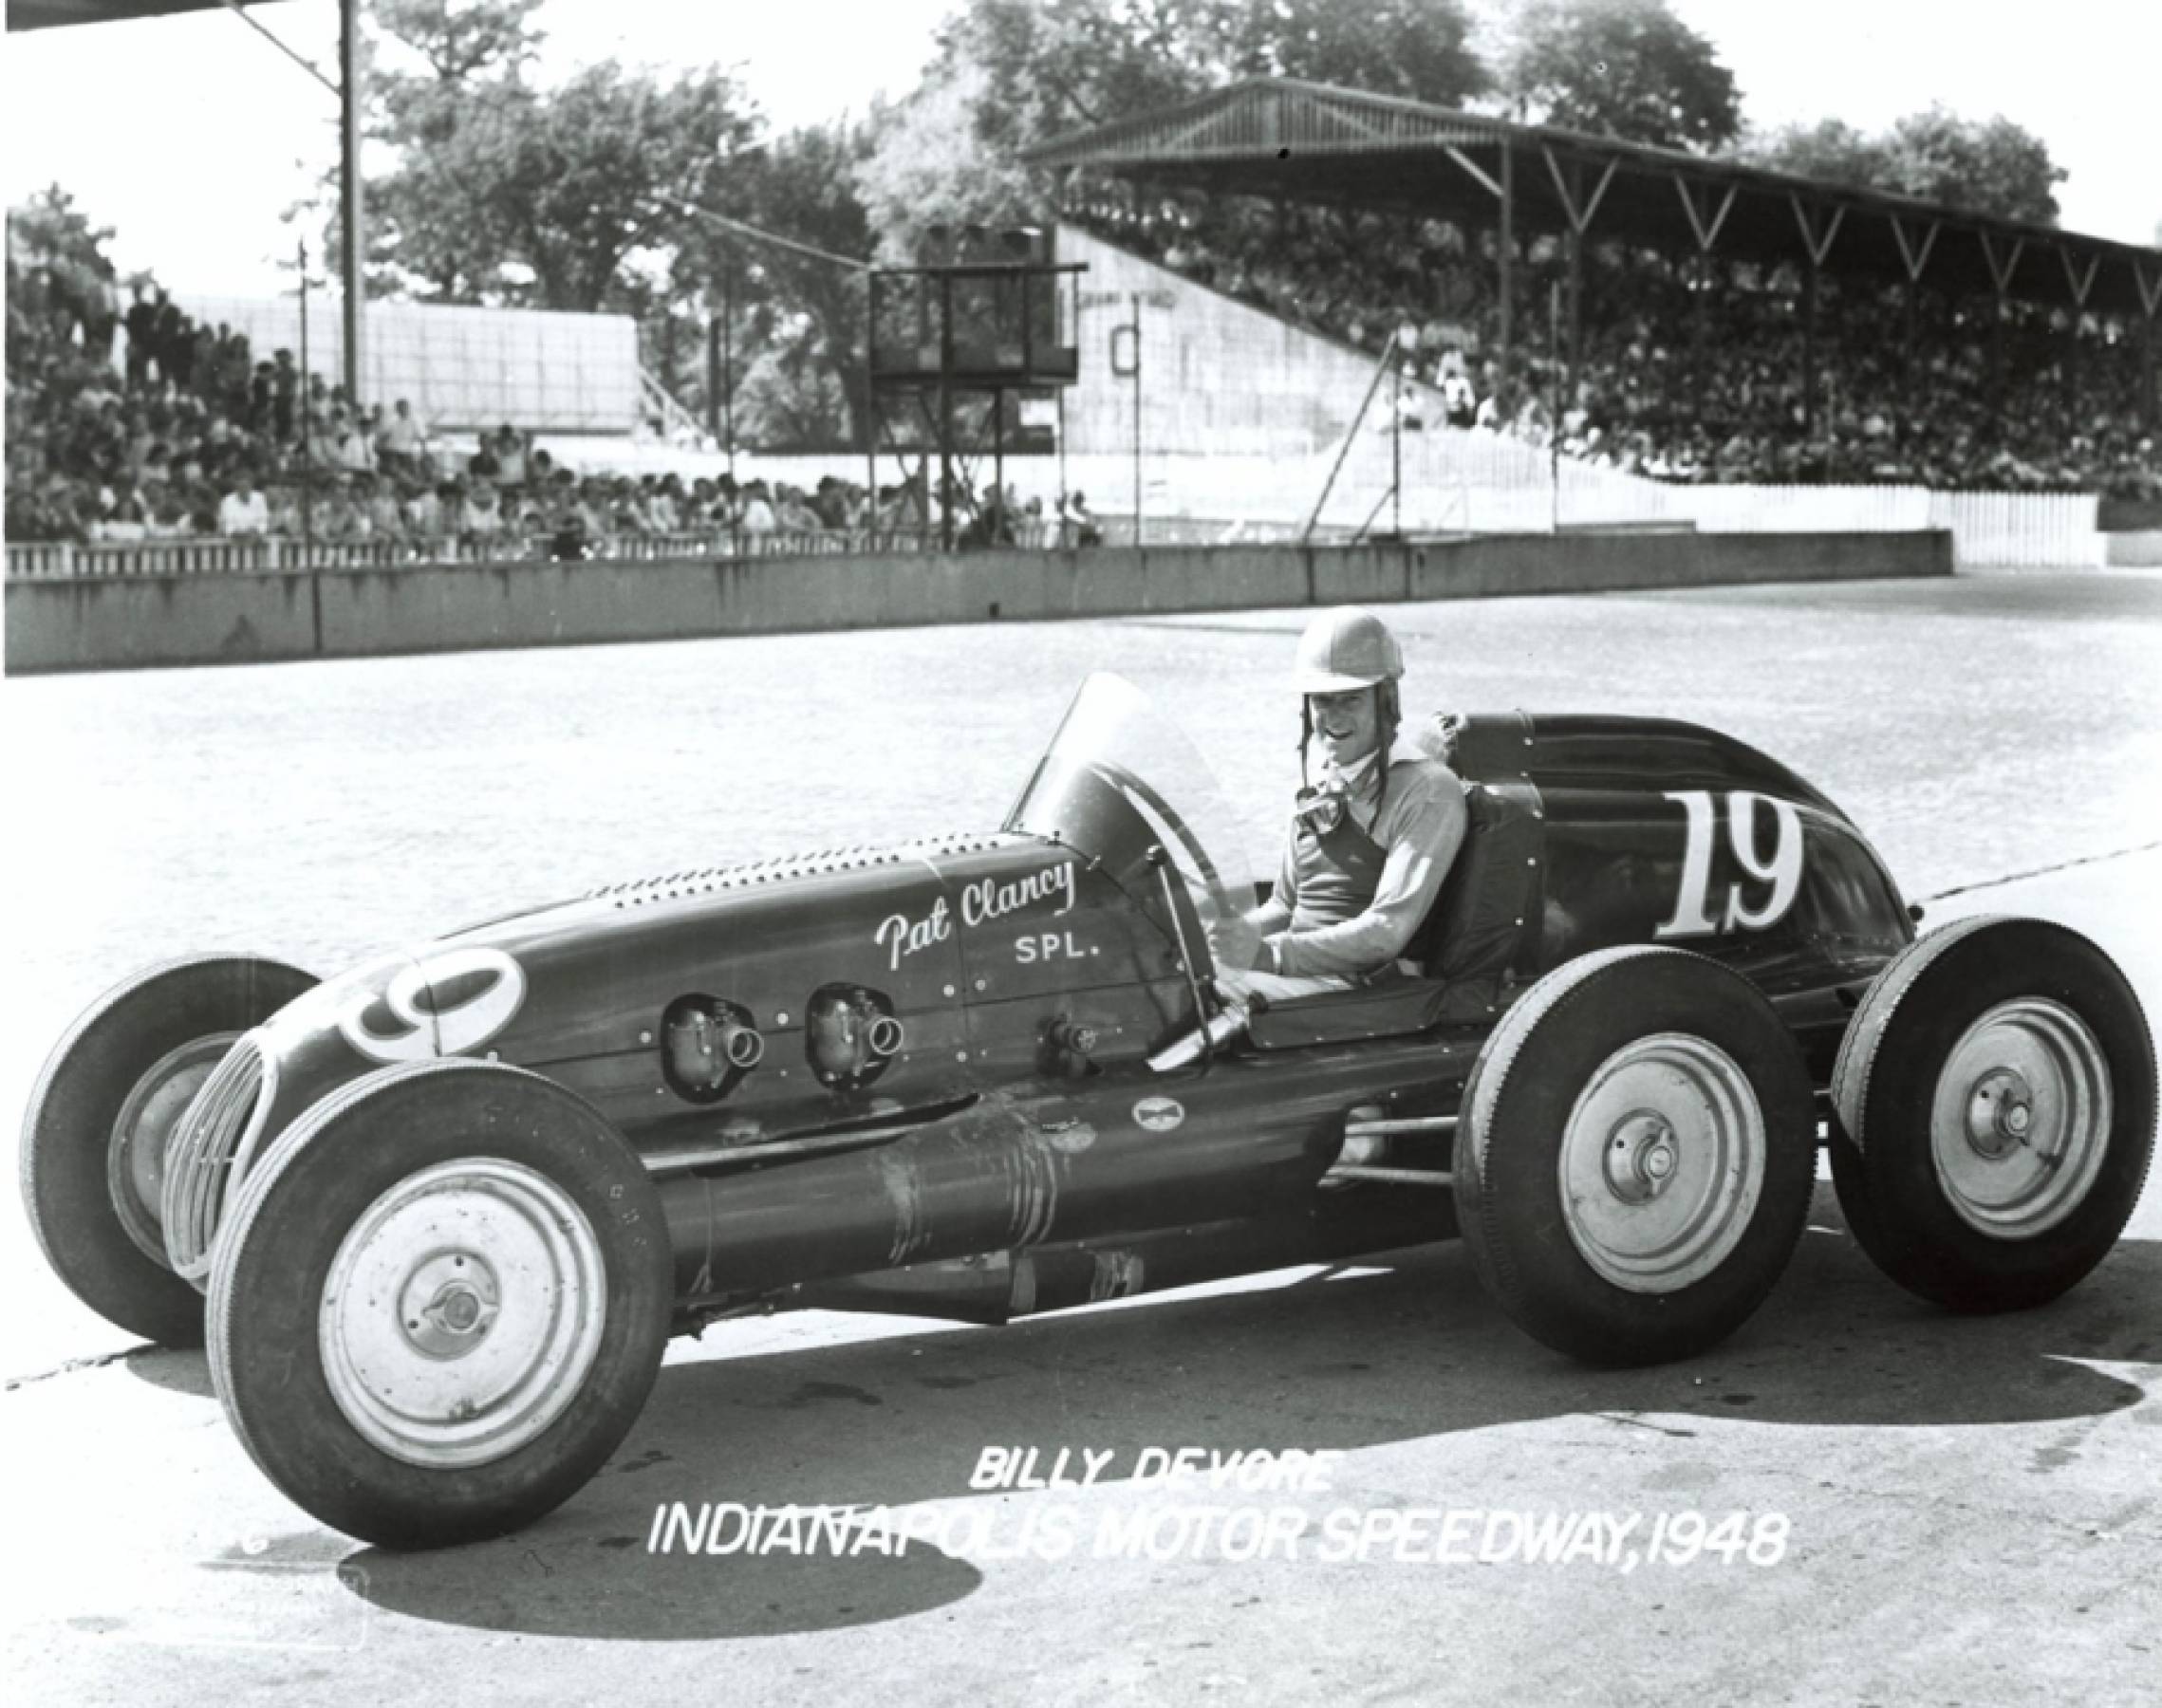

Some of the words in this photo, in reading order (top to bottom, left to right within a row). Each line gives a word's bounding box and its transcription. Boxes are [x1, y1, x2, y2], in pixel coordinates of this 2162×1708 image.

[874, 895, 951, 971] Pat
[960, 861, 1075, 927] Clancy
[1654, 789, 1803, 939] 19
[1014, 931, 1101, 964] SPL.
